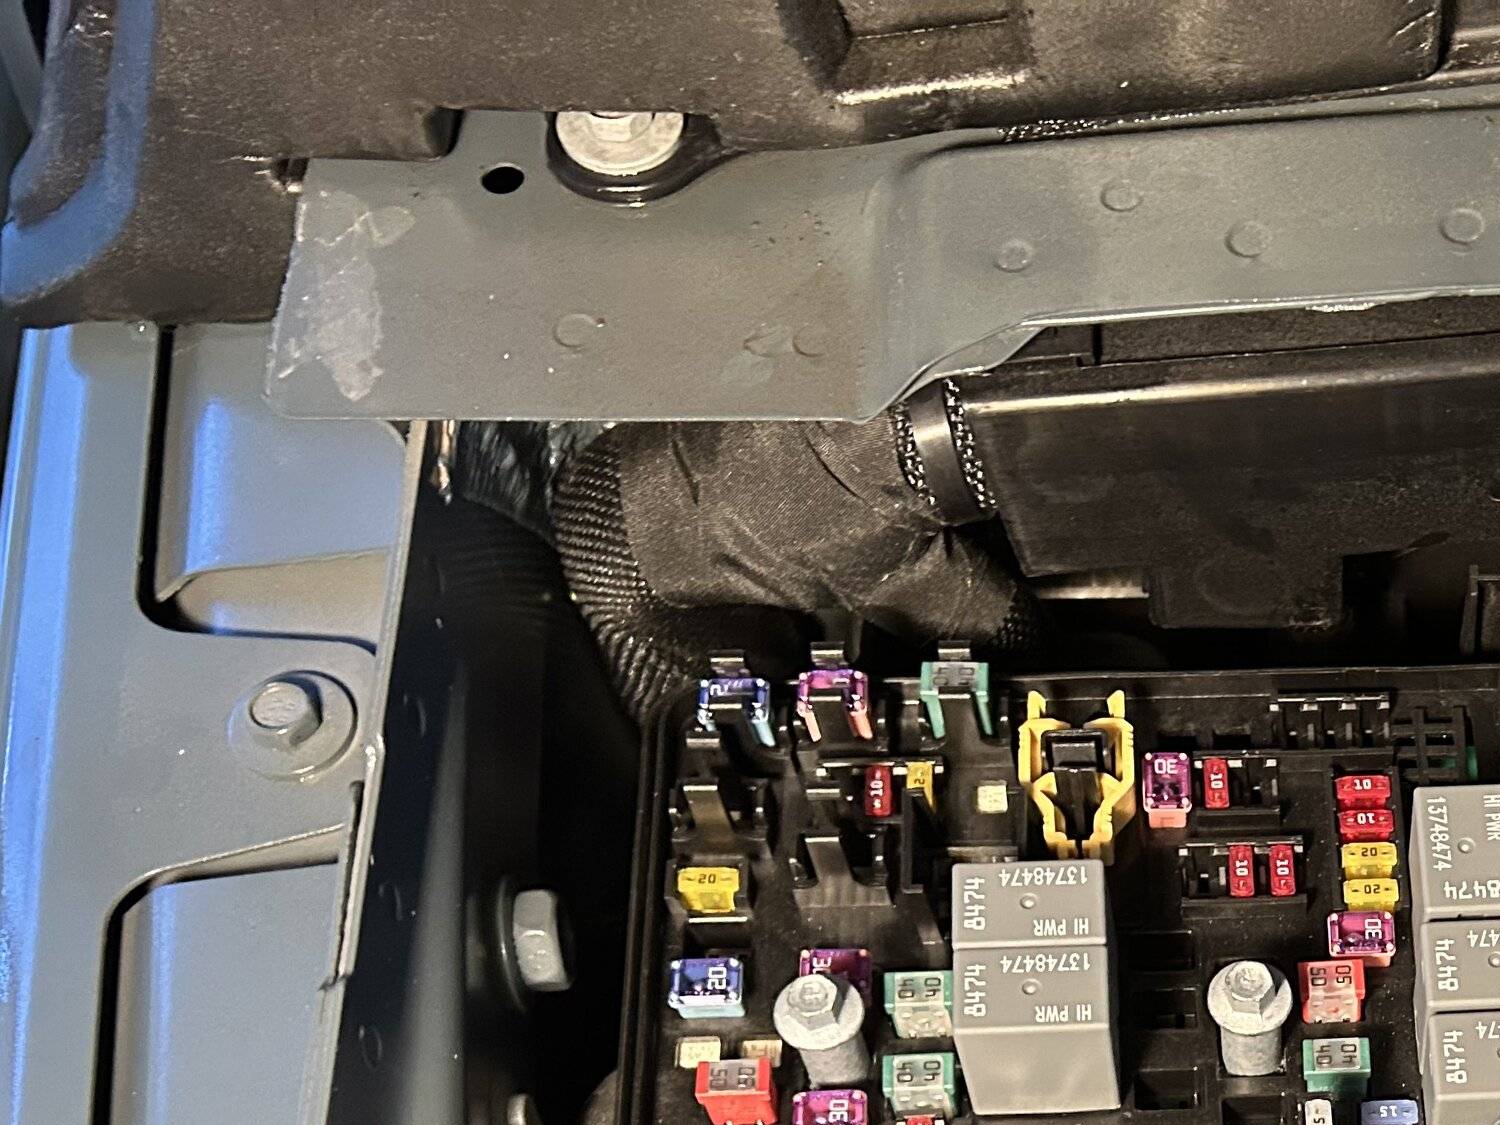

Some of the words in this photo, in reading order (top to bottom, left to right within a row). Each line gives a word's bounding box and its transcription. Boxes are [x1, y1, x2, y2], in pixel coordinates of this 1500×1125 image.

[1154, 760, 1178, 774] 30
[1210, 774, 1223, 790] 10
[1353, 779, 1372, 790] 10
[1357, 813, 1375, 824] 10
[1426, 797, 1451, 872] 13748474
[1361, 847, 1378, 857] 20
[998, 866, 1088, 887] 13748474
[1236, 860, 1248, 876] 10
[1278, 860, 1289, 876] 10
[698, 874, 716, 884] 20
[1364, 884, 1380, 894] 20
[1444, 880, 1500, 900] 8474
[964, 876, 986, 930] 8474
[1033, 918, 1066, 937] PWR
[1074, 918, 1089, 935] HI
[1364, 918, 1382, 939] 30
[1000, 952, 1090, 974] 13748474
[1435, 938, 1458, 991] 8474
[708, 966, 727, 990] 20
[964, 964, 986, 1018] 8474
[1035, 1005, 1068, 1023] PWR
[1076, 1004, 1092, 1021] HI
[1443, 1030, 1468, 1084] 8474
[829, 1099, 848, 1122] 30
[1380, 1106, 1398, 1118] 15
